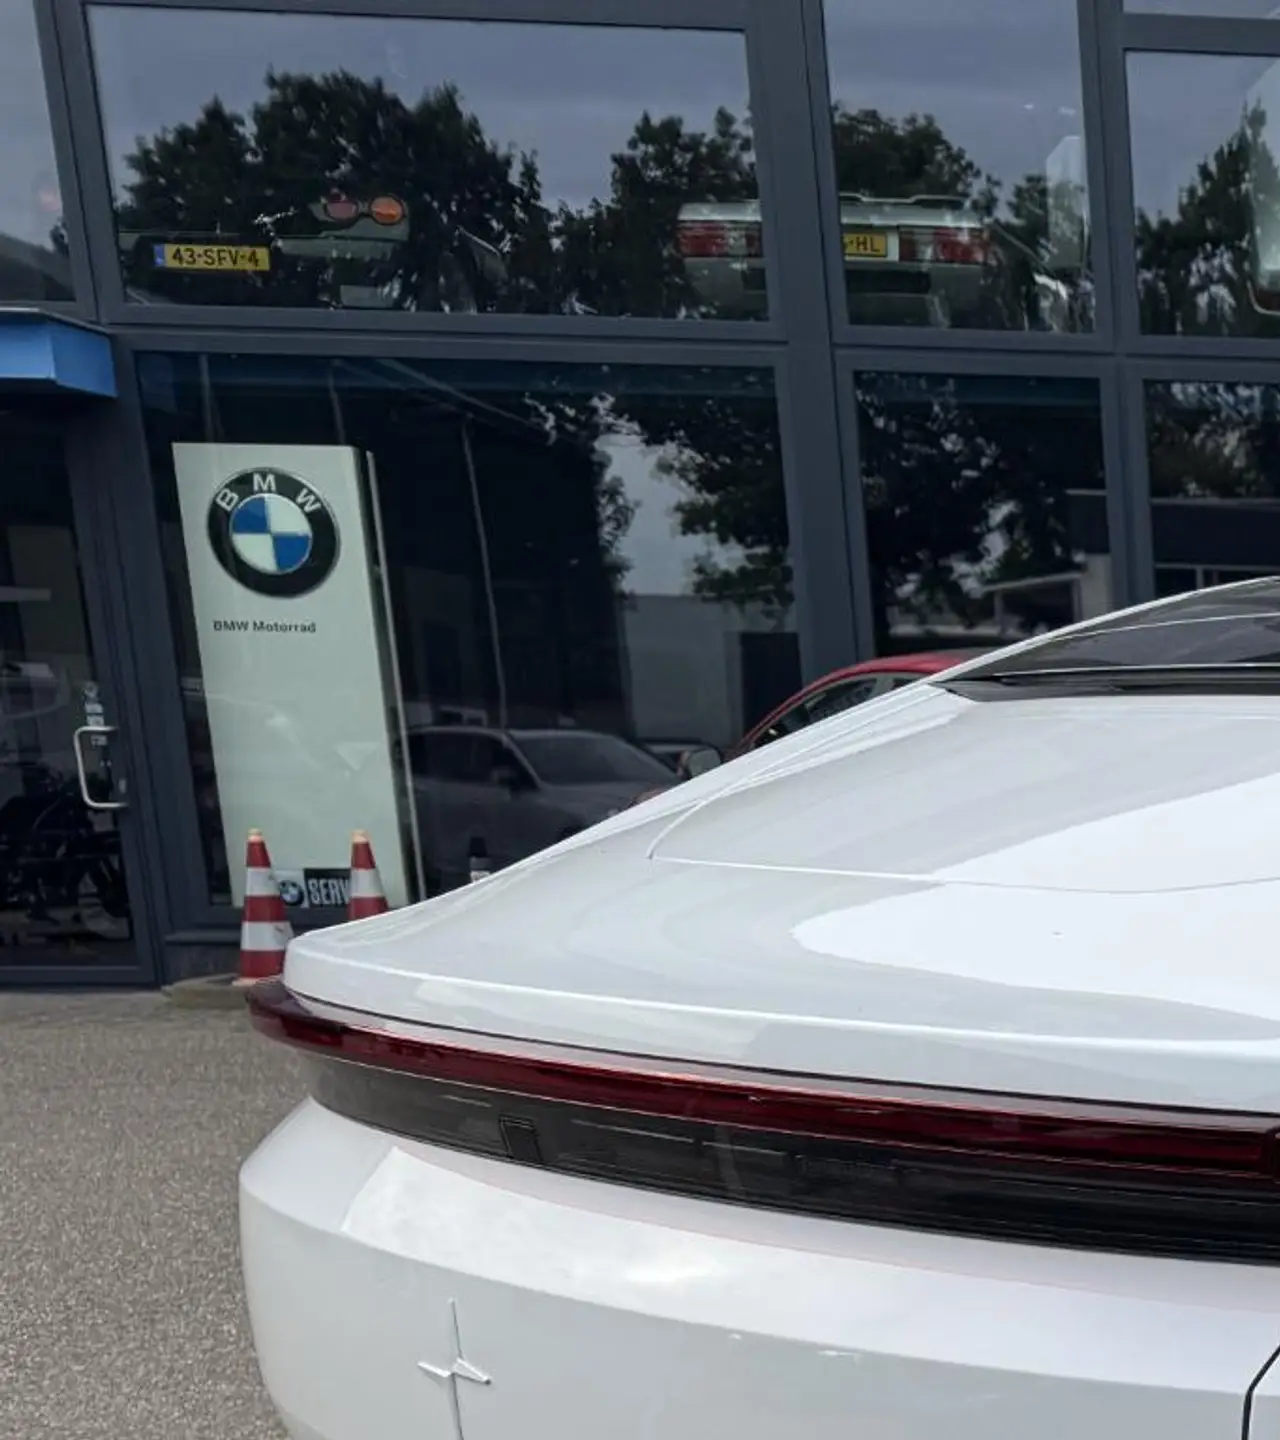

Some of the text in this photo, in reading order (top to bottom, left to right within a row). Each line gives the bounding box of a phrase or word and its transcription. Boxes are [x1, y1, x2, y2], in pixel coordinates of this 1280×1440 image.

[843, 235, 881, 252] -HL
[215, 473, 322, 514] BMW
[213, 620, 317, 633] BMW Motorrad
